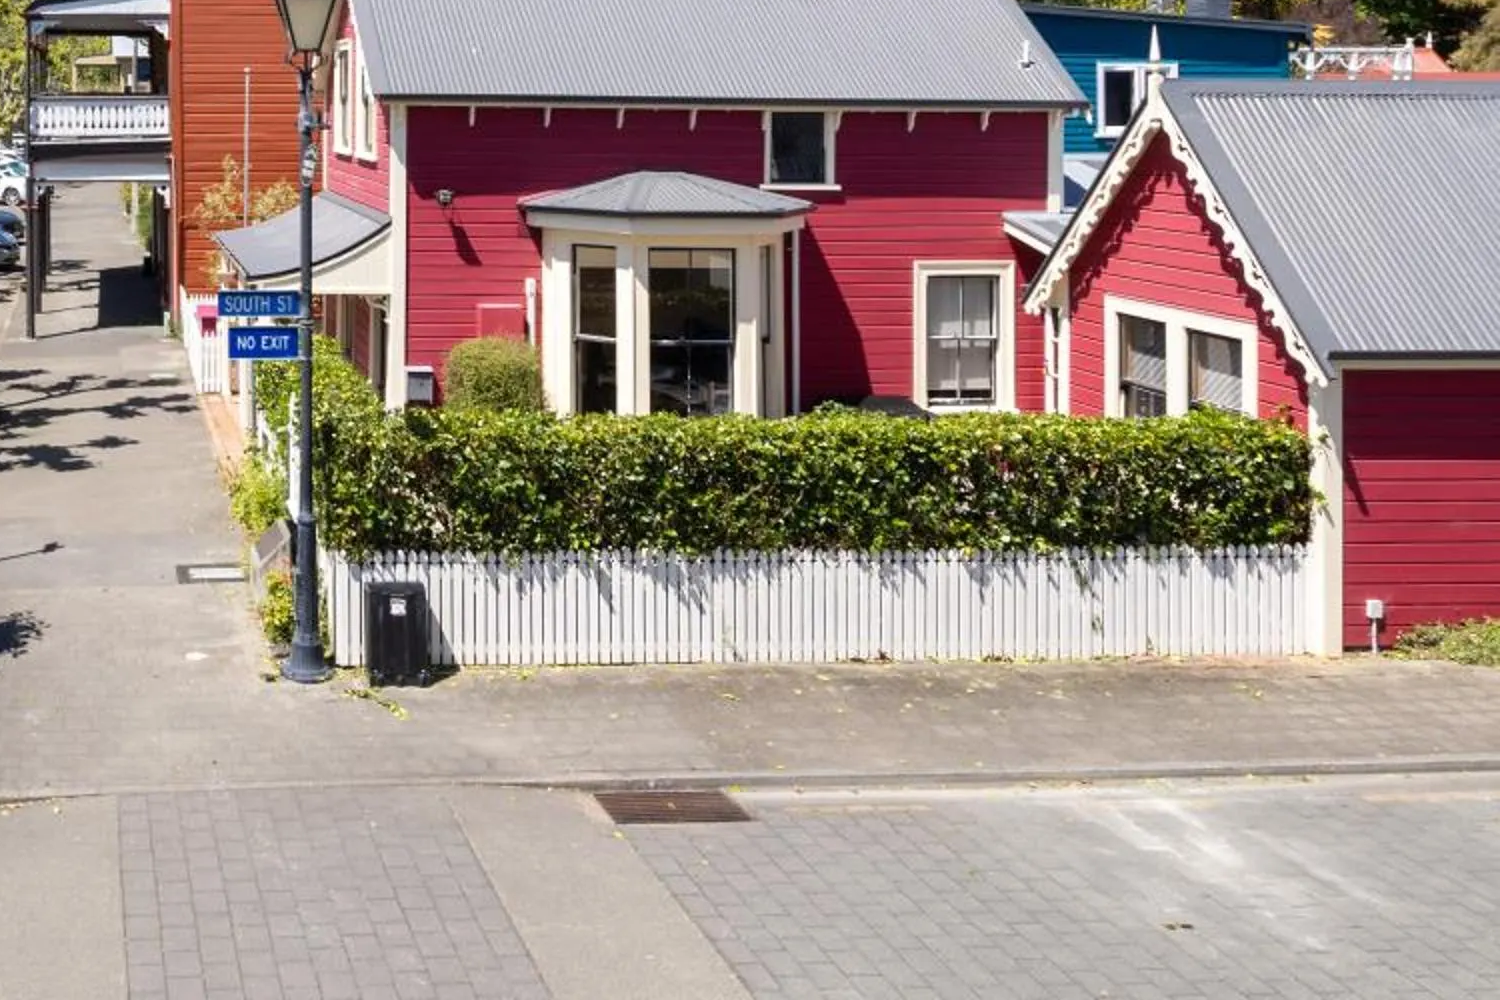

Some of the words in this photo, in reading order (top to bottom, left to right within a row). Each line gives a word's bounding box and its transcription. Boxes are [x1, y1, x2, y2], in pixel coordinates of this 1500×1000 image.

[224, 295, 270, 313] SOUTH
[277, 295, 293, 313] ST
[237, 335, 256, 350] NO
[261, 335, 290, 350] EXIT
